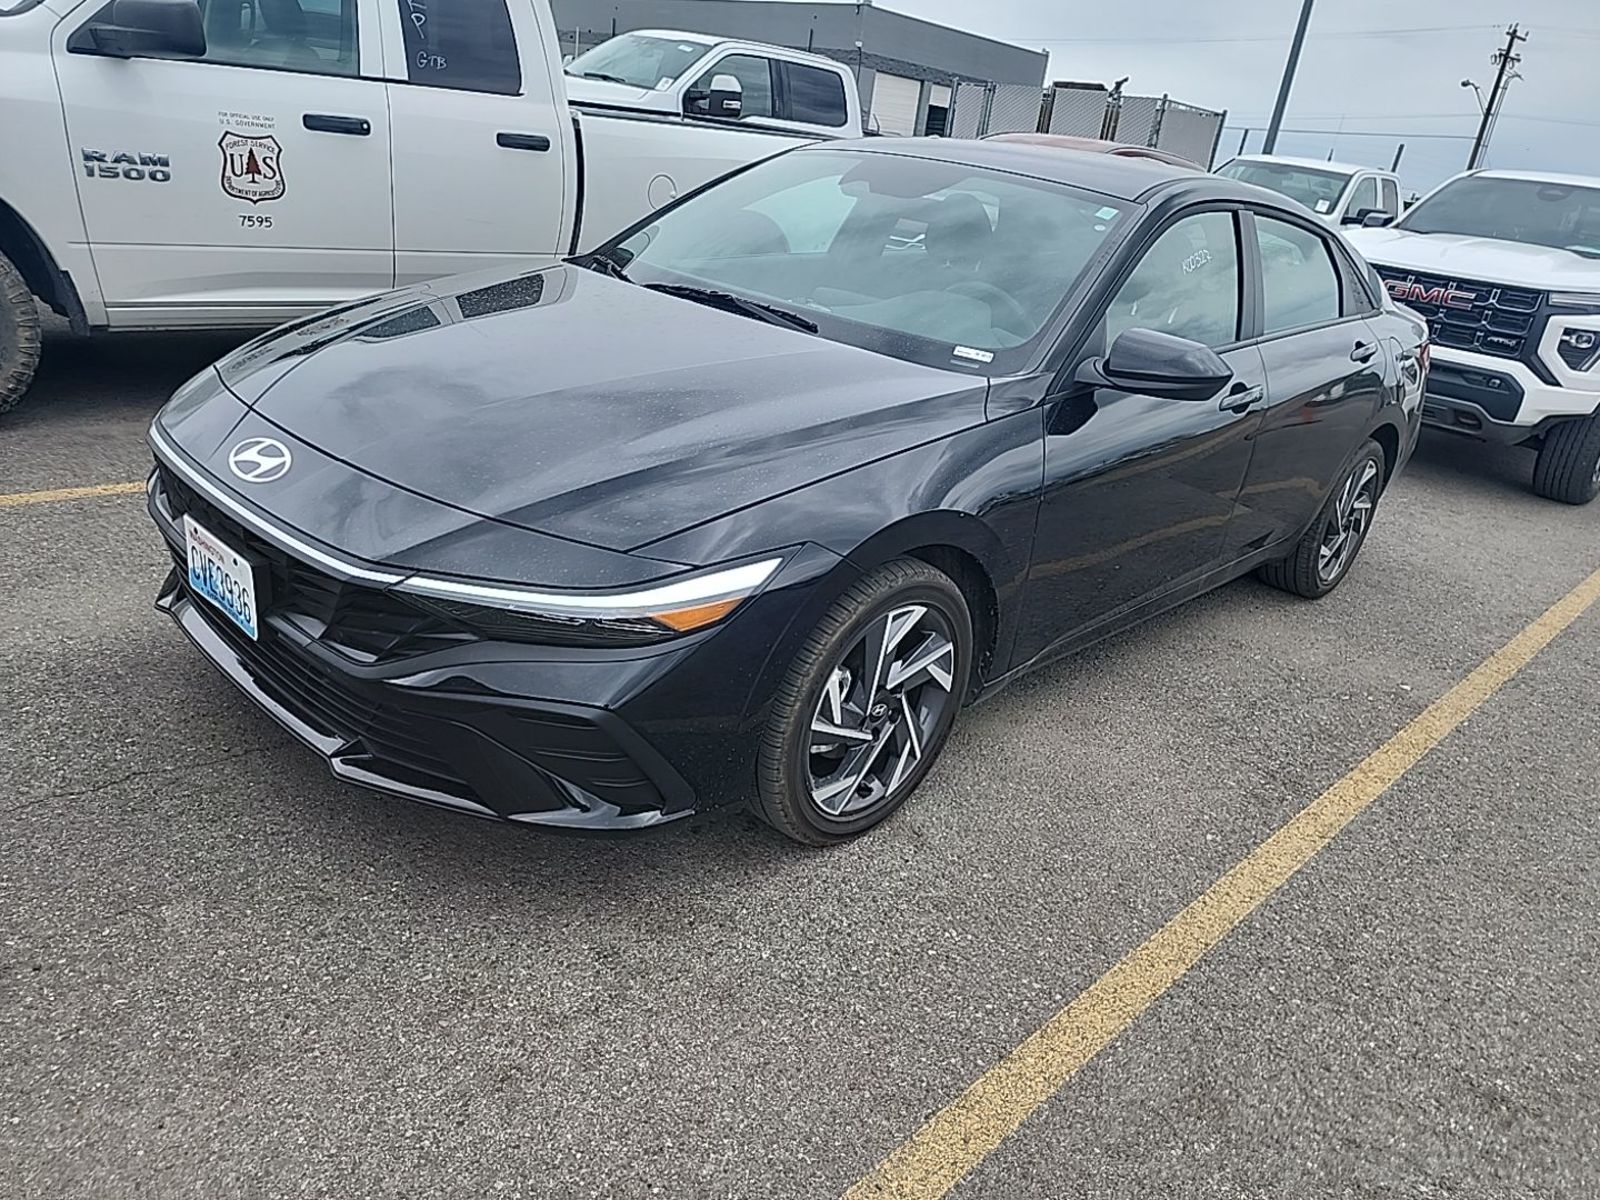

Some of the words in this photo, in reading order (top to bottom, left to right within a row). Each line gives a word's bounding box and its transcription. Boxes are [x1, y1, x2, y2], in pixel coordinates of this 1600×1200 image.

[416, 51, 447, 70] GTB
[234, 119, 276, 129] GOVERNMENT
[225, 139, 249, 151] FOREST
[250, 140, 276, 155] SERVICE
[81, 147, 170, 168] RAM
[84, 163, 171, 182] 1500
[238, 215, 273, 228] 7595
[1384, 279, 1476, 311] GMC
